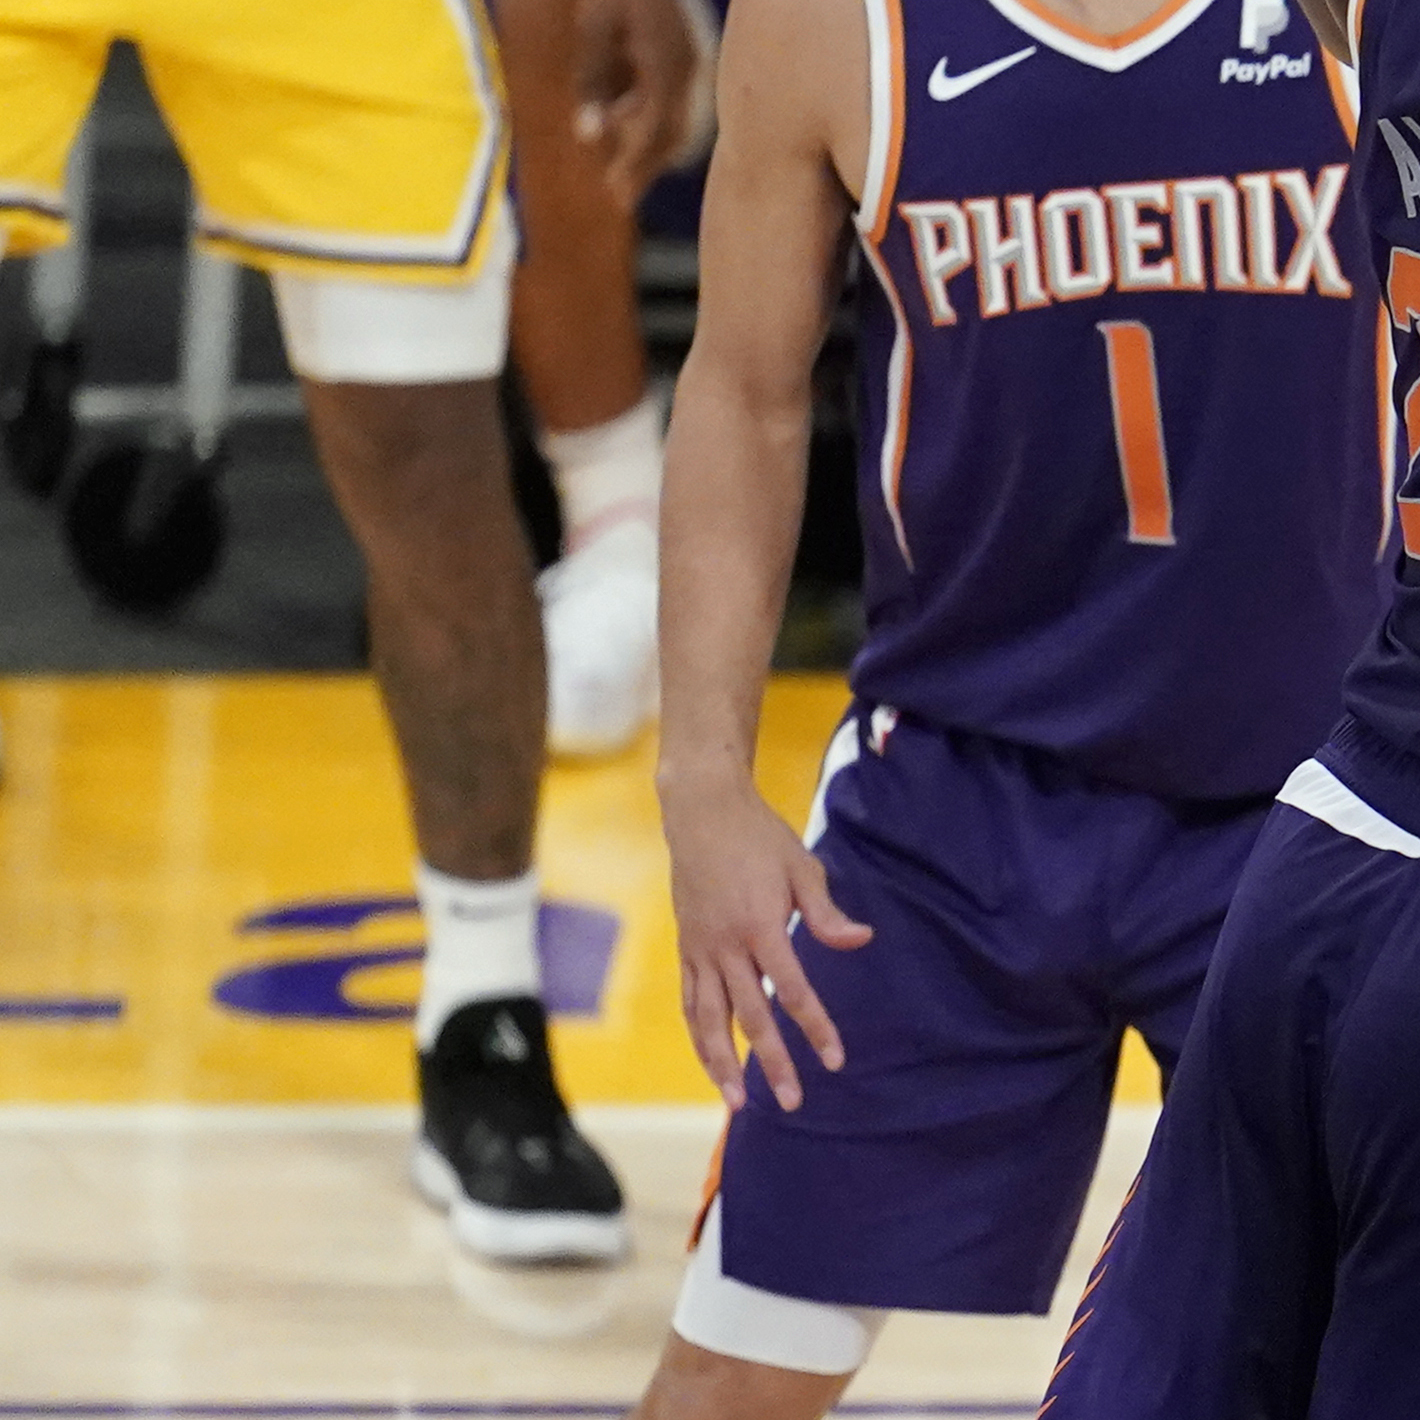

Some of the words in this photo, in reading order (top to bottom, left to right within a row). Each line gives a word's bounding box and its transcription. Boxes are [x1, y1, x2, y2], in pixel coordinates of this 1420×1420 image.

[1219, 52, 1312, 85] PayPal
[899, 163, 1353, 327] PHOENIX
[1097, 320, 1176, 545] 1
